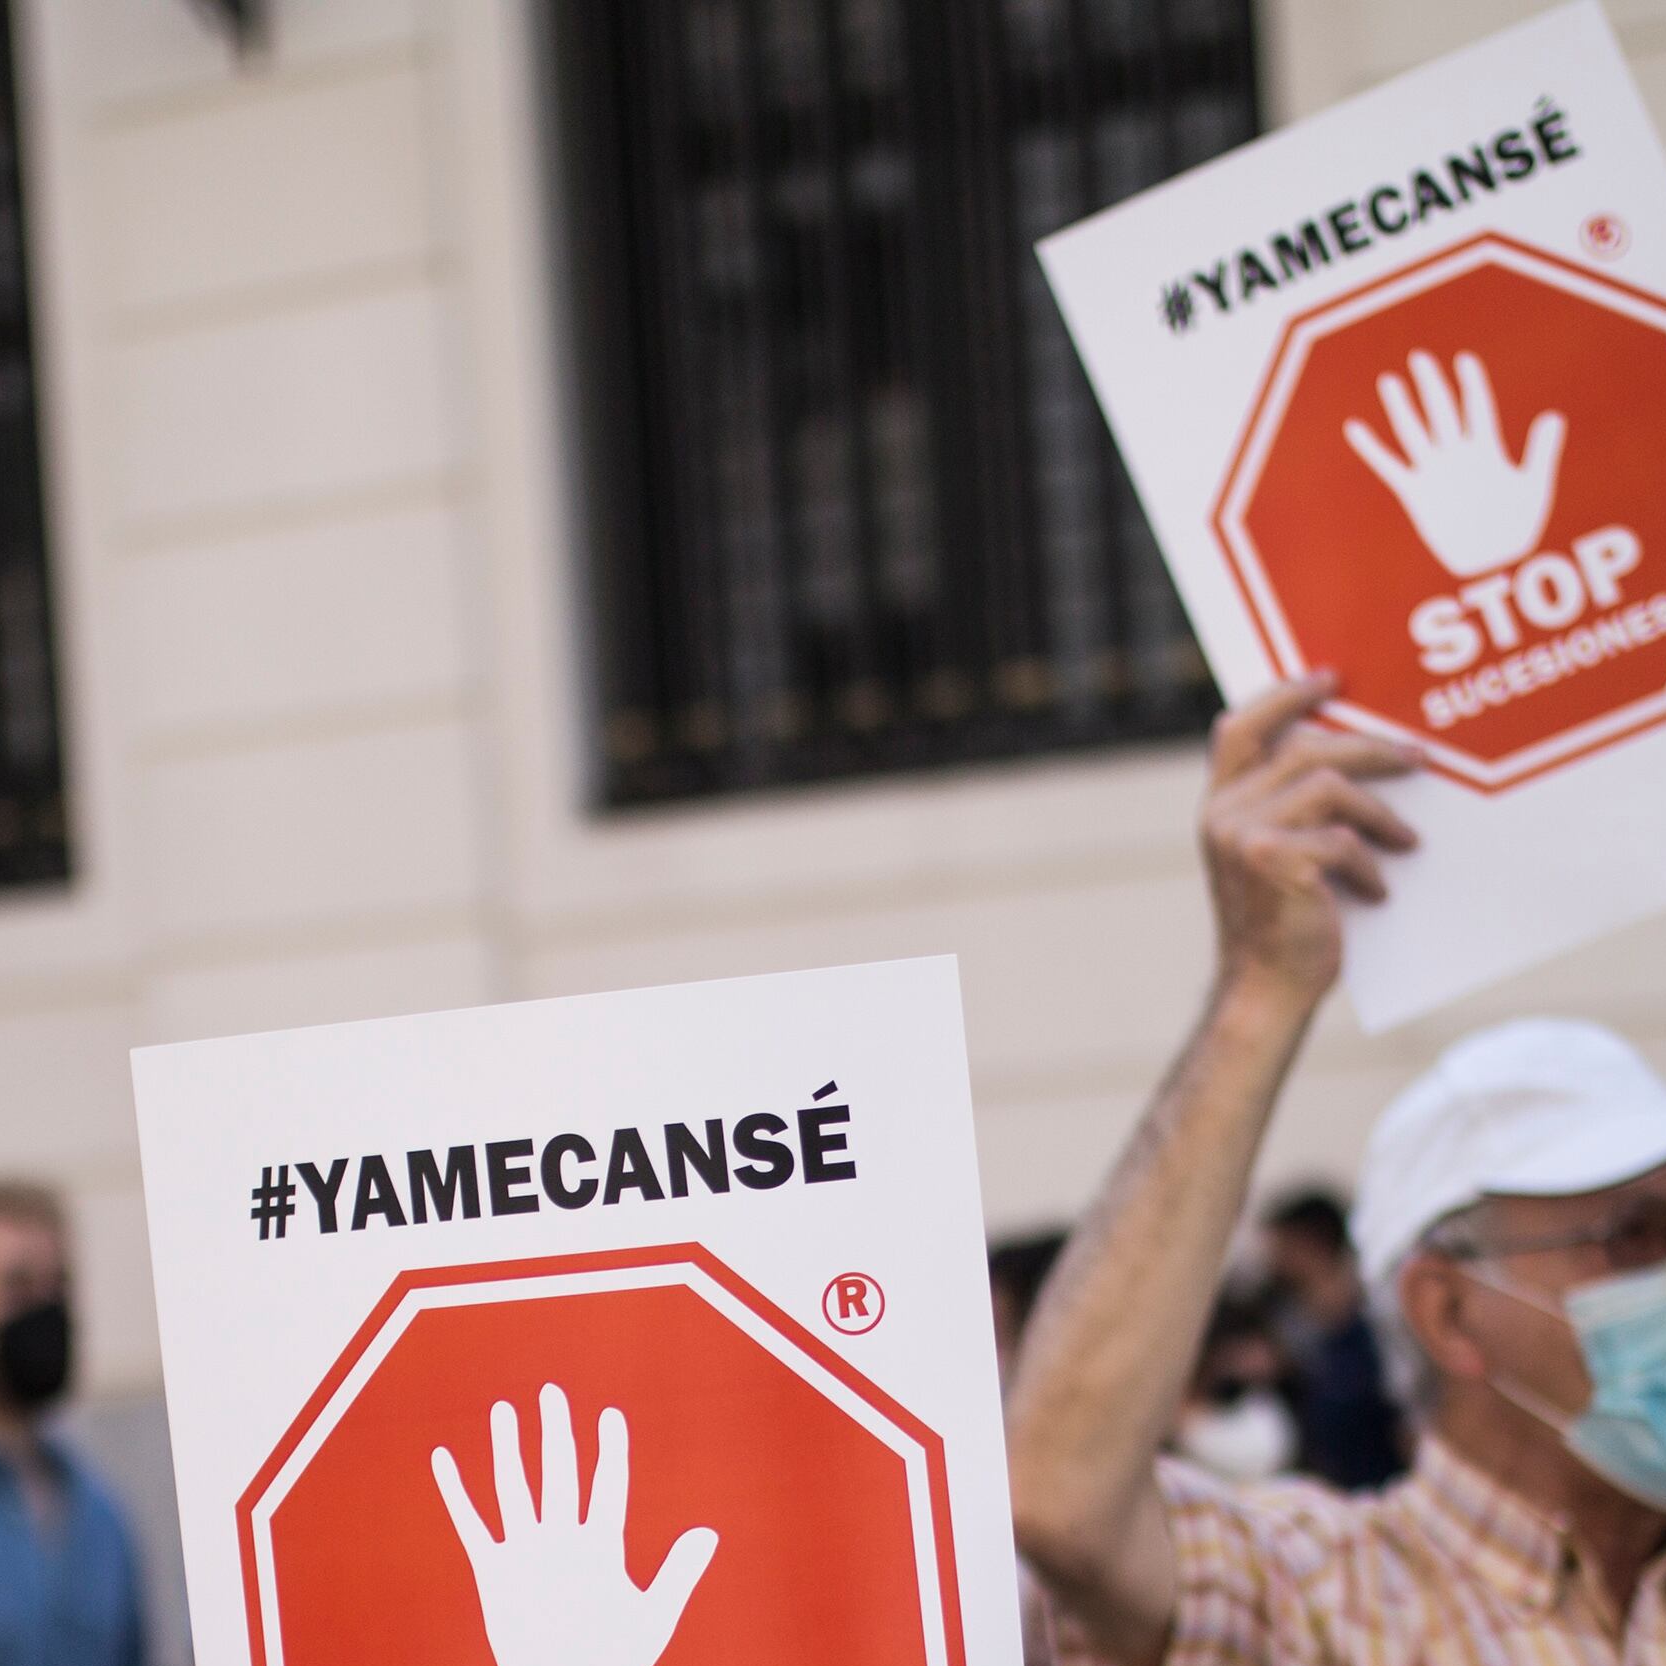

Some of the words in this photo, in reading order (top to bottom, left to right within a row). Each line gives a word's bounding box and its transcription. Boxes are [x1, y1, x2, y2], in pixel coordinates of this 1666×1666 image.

[1159, 96, 1582, 335] #YAMECANSÉ
[1408, 527, 1641, 674] STOP
[253, 1082, 856, 1240] #YAMECANSÉ
